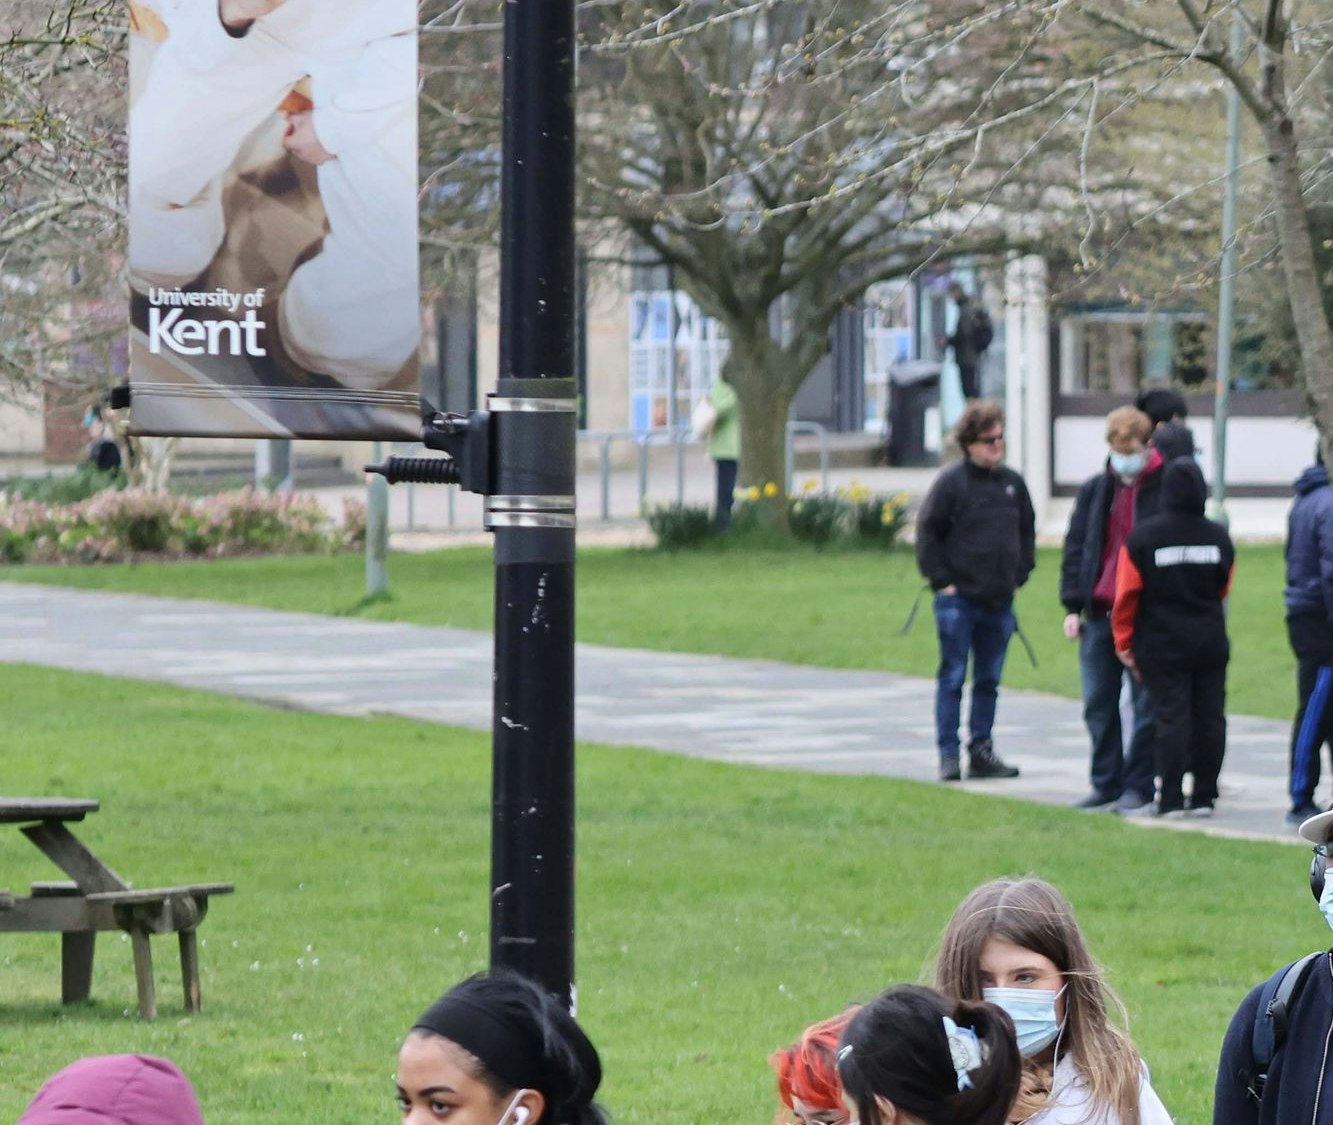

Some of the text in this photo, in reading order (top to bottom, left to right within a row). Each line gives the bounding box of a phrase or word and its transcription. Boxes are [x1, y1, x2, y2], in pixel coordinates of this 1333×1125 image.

[149, 288, 266, 311] University of
[149, 307, 267, 357] Kent
